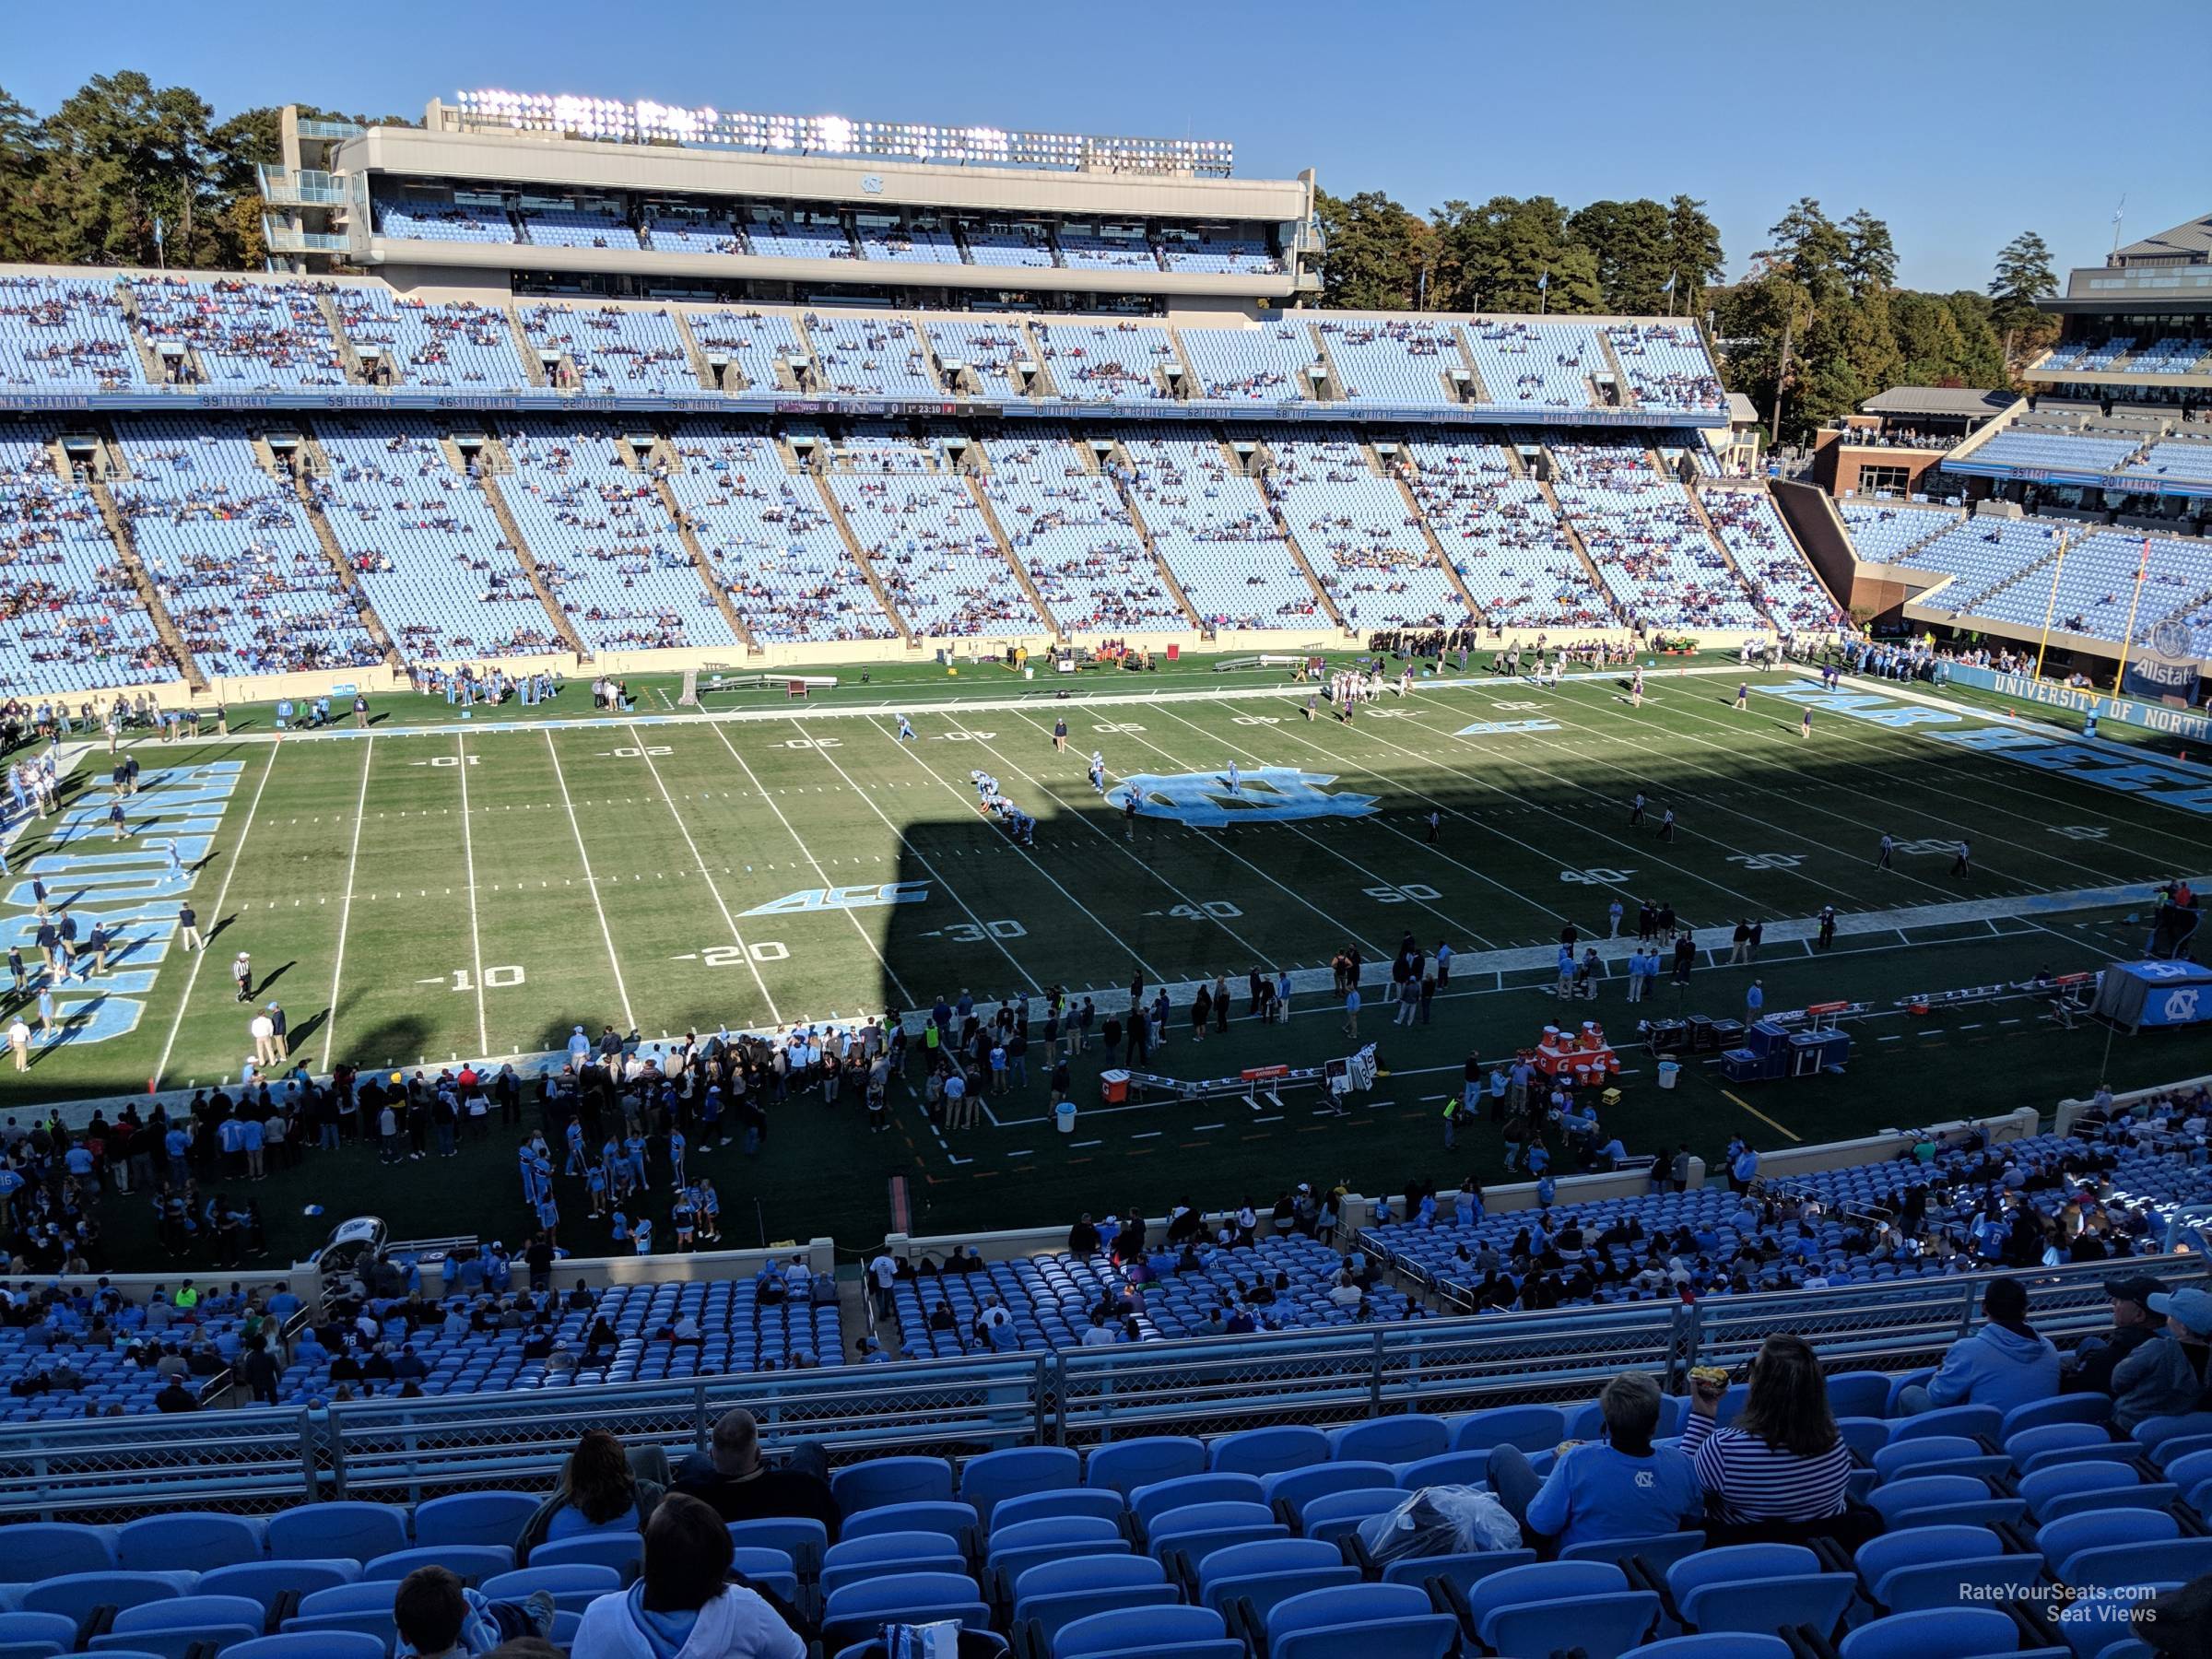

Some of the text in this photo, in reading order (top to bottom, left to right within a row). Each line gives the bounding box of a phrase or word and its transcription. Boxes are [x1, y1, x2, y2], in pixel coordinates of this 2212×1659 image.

[31, 396, 88, 408] STADIUM
[202, 397, 267, 407] 99 BARCLAY
[328, 397, 344, 407] 59
[438, 397, 517, 408] 46 SUTHERLAND
[562, 398, 618, 409] 22 JUSTICE
[672, 400, 720, 411] 50 WEINER
[803, 402, 819, 411] WCU
[827, 402, 834, 413] 0
[891, 403, 899, 414] 0
[919, 405, 941, 414] 23:10
[1034, 406, 1079, 416] 10 TALBOTT
[1111, 407, 1123, 417] 23
[1187, 408, 1231, 418] 62 RUSNAK
[1276, 410, 1309, 419] 68 HUFF
[1349, 411, 1361, 420] 44
[1543, 415, 1672, 426] WELCOME TO KENAN STADIUM
[2012, 467, 2024, 477] 85
[2101, 476, 2161, 491] 20 LAWRENCE
[2132, 655, 2198, 687] Allstate
[1994, 674, 2208, 740] UNIVERSITY OF NORTH
[1231, 715, 1280, 725] 40
[1092, 723, 1147, 734] 50
[944, 731, 997, 741] 40
[785, 737, 843, 749] 30
[614, 746, 674, 759] 20
[431, 755, 480, 767] 10
[1725, 853, 1802, 870] 30
[1559, 868, 1630, 885] 40
[735, 879, 934, 918] ACC
[1361, 883, 1444, 904] 50
[1169, 901, 1244, 922] 40
[948, 920, 1029, 942] 30
[701, 941, 791, 967] 20
[452, 965, 525, 992] 10
[1557, 1058, 1570, 1073] G
[1102, 1082, 1110, 1095] G
[342, 1335, 358, 1347] 78
